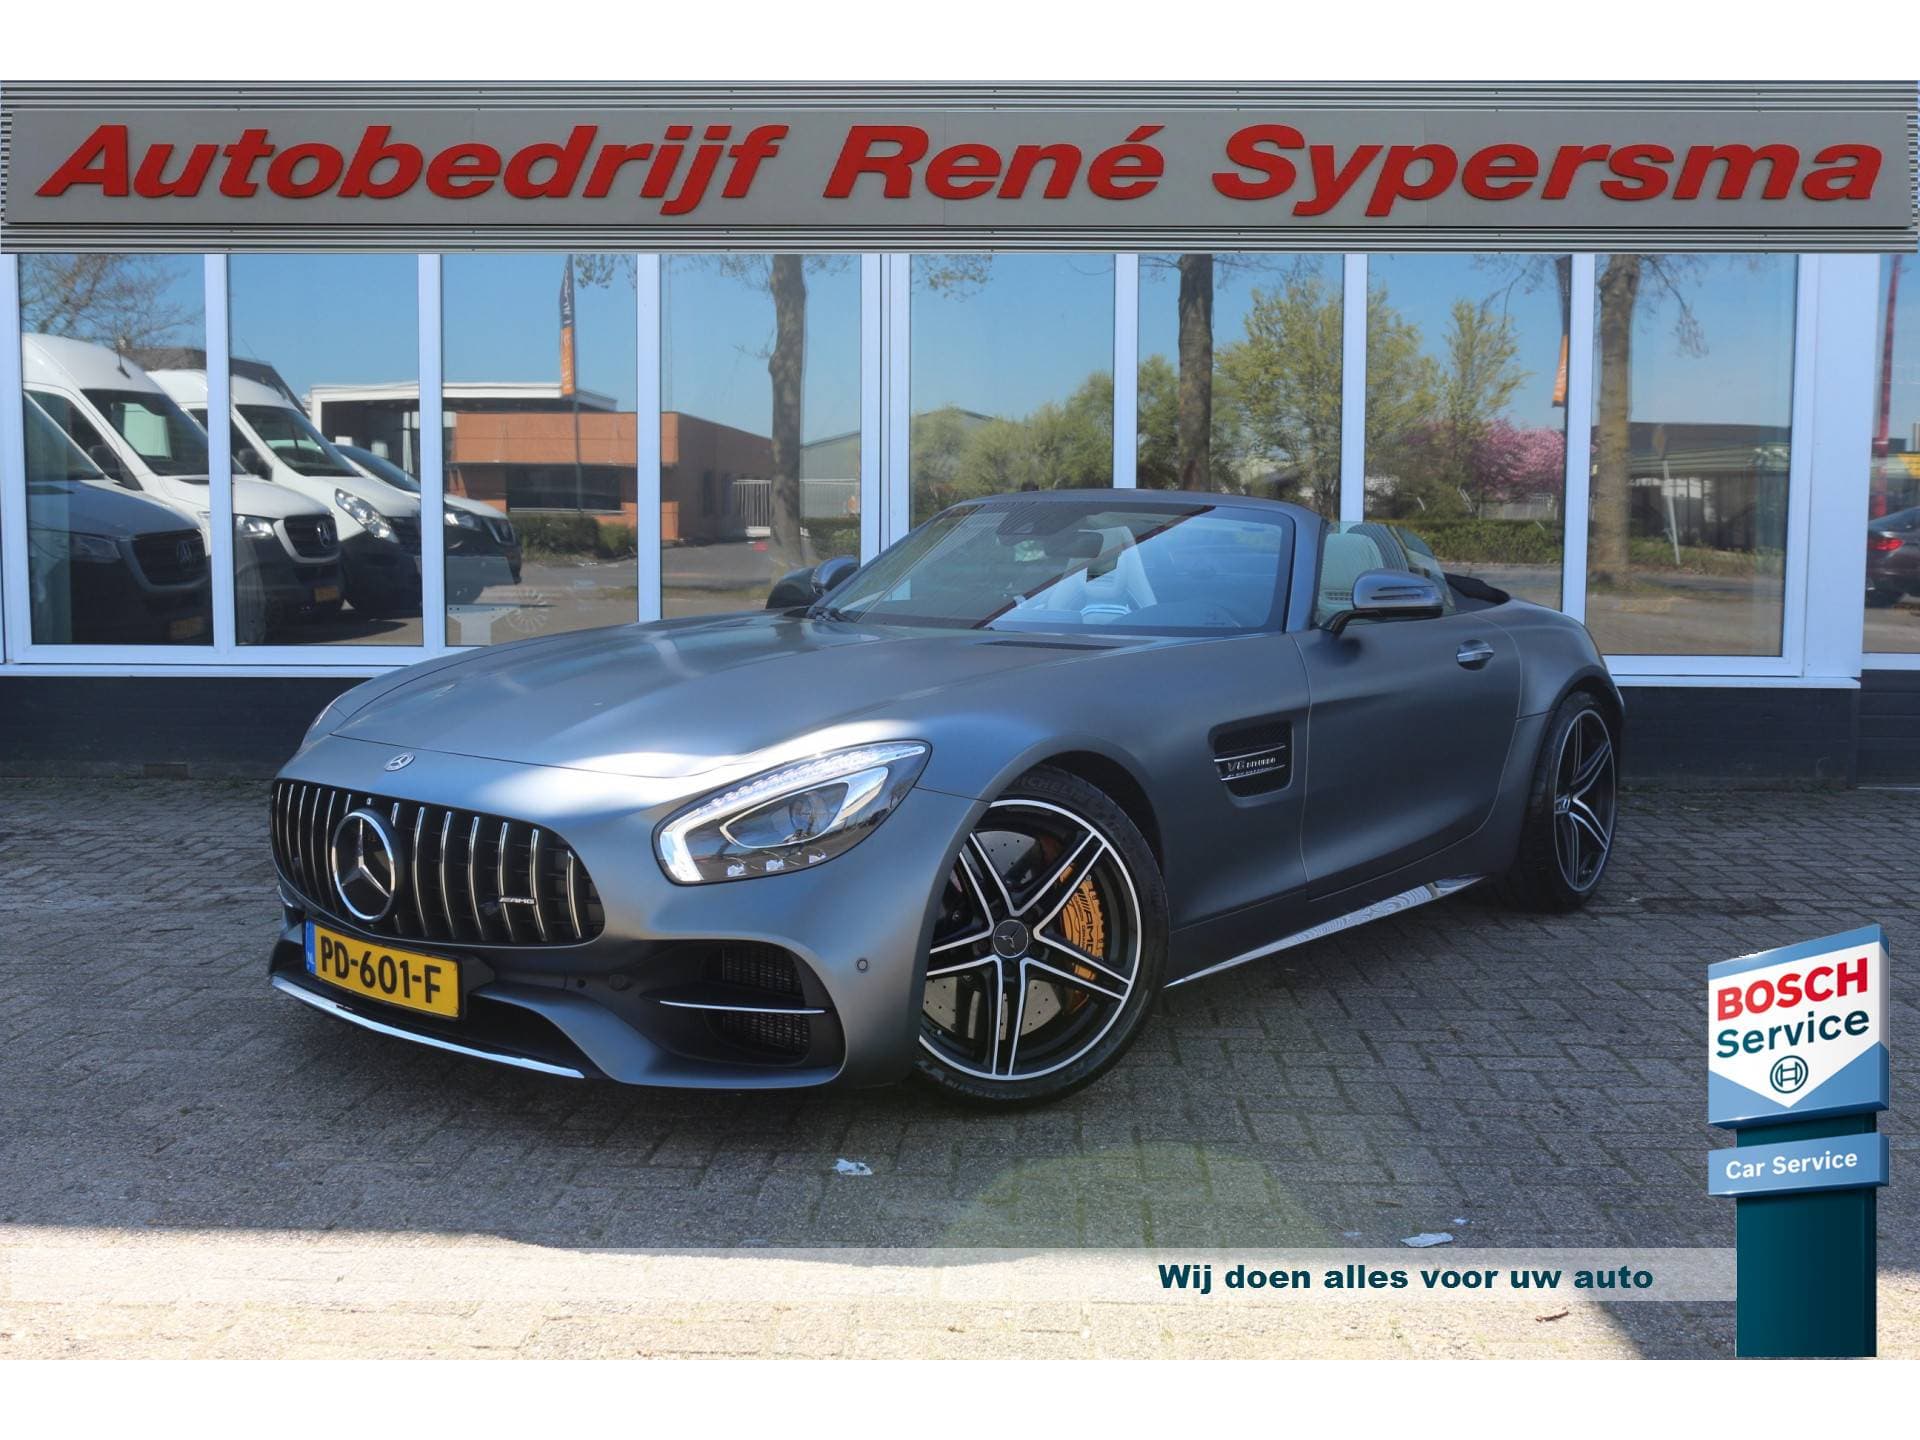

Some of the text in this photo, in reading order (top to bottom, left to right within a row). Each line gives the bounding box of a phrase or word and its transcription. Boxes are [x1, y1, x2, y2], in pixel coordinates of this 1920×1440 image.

[36, 124, 1883, 217] Autobedrijf René Sypersma
[320, 935, 442, 1004] PD-601-F
